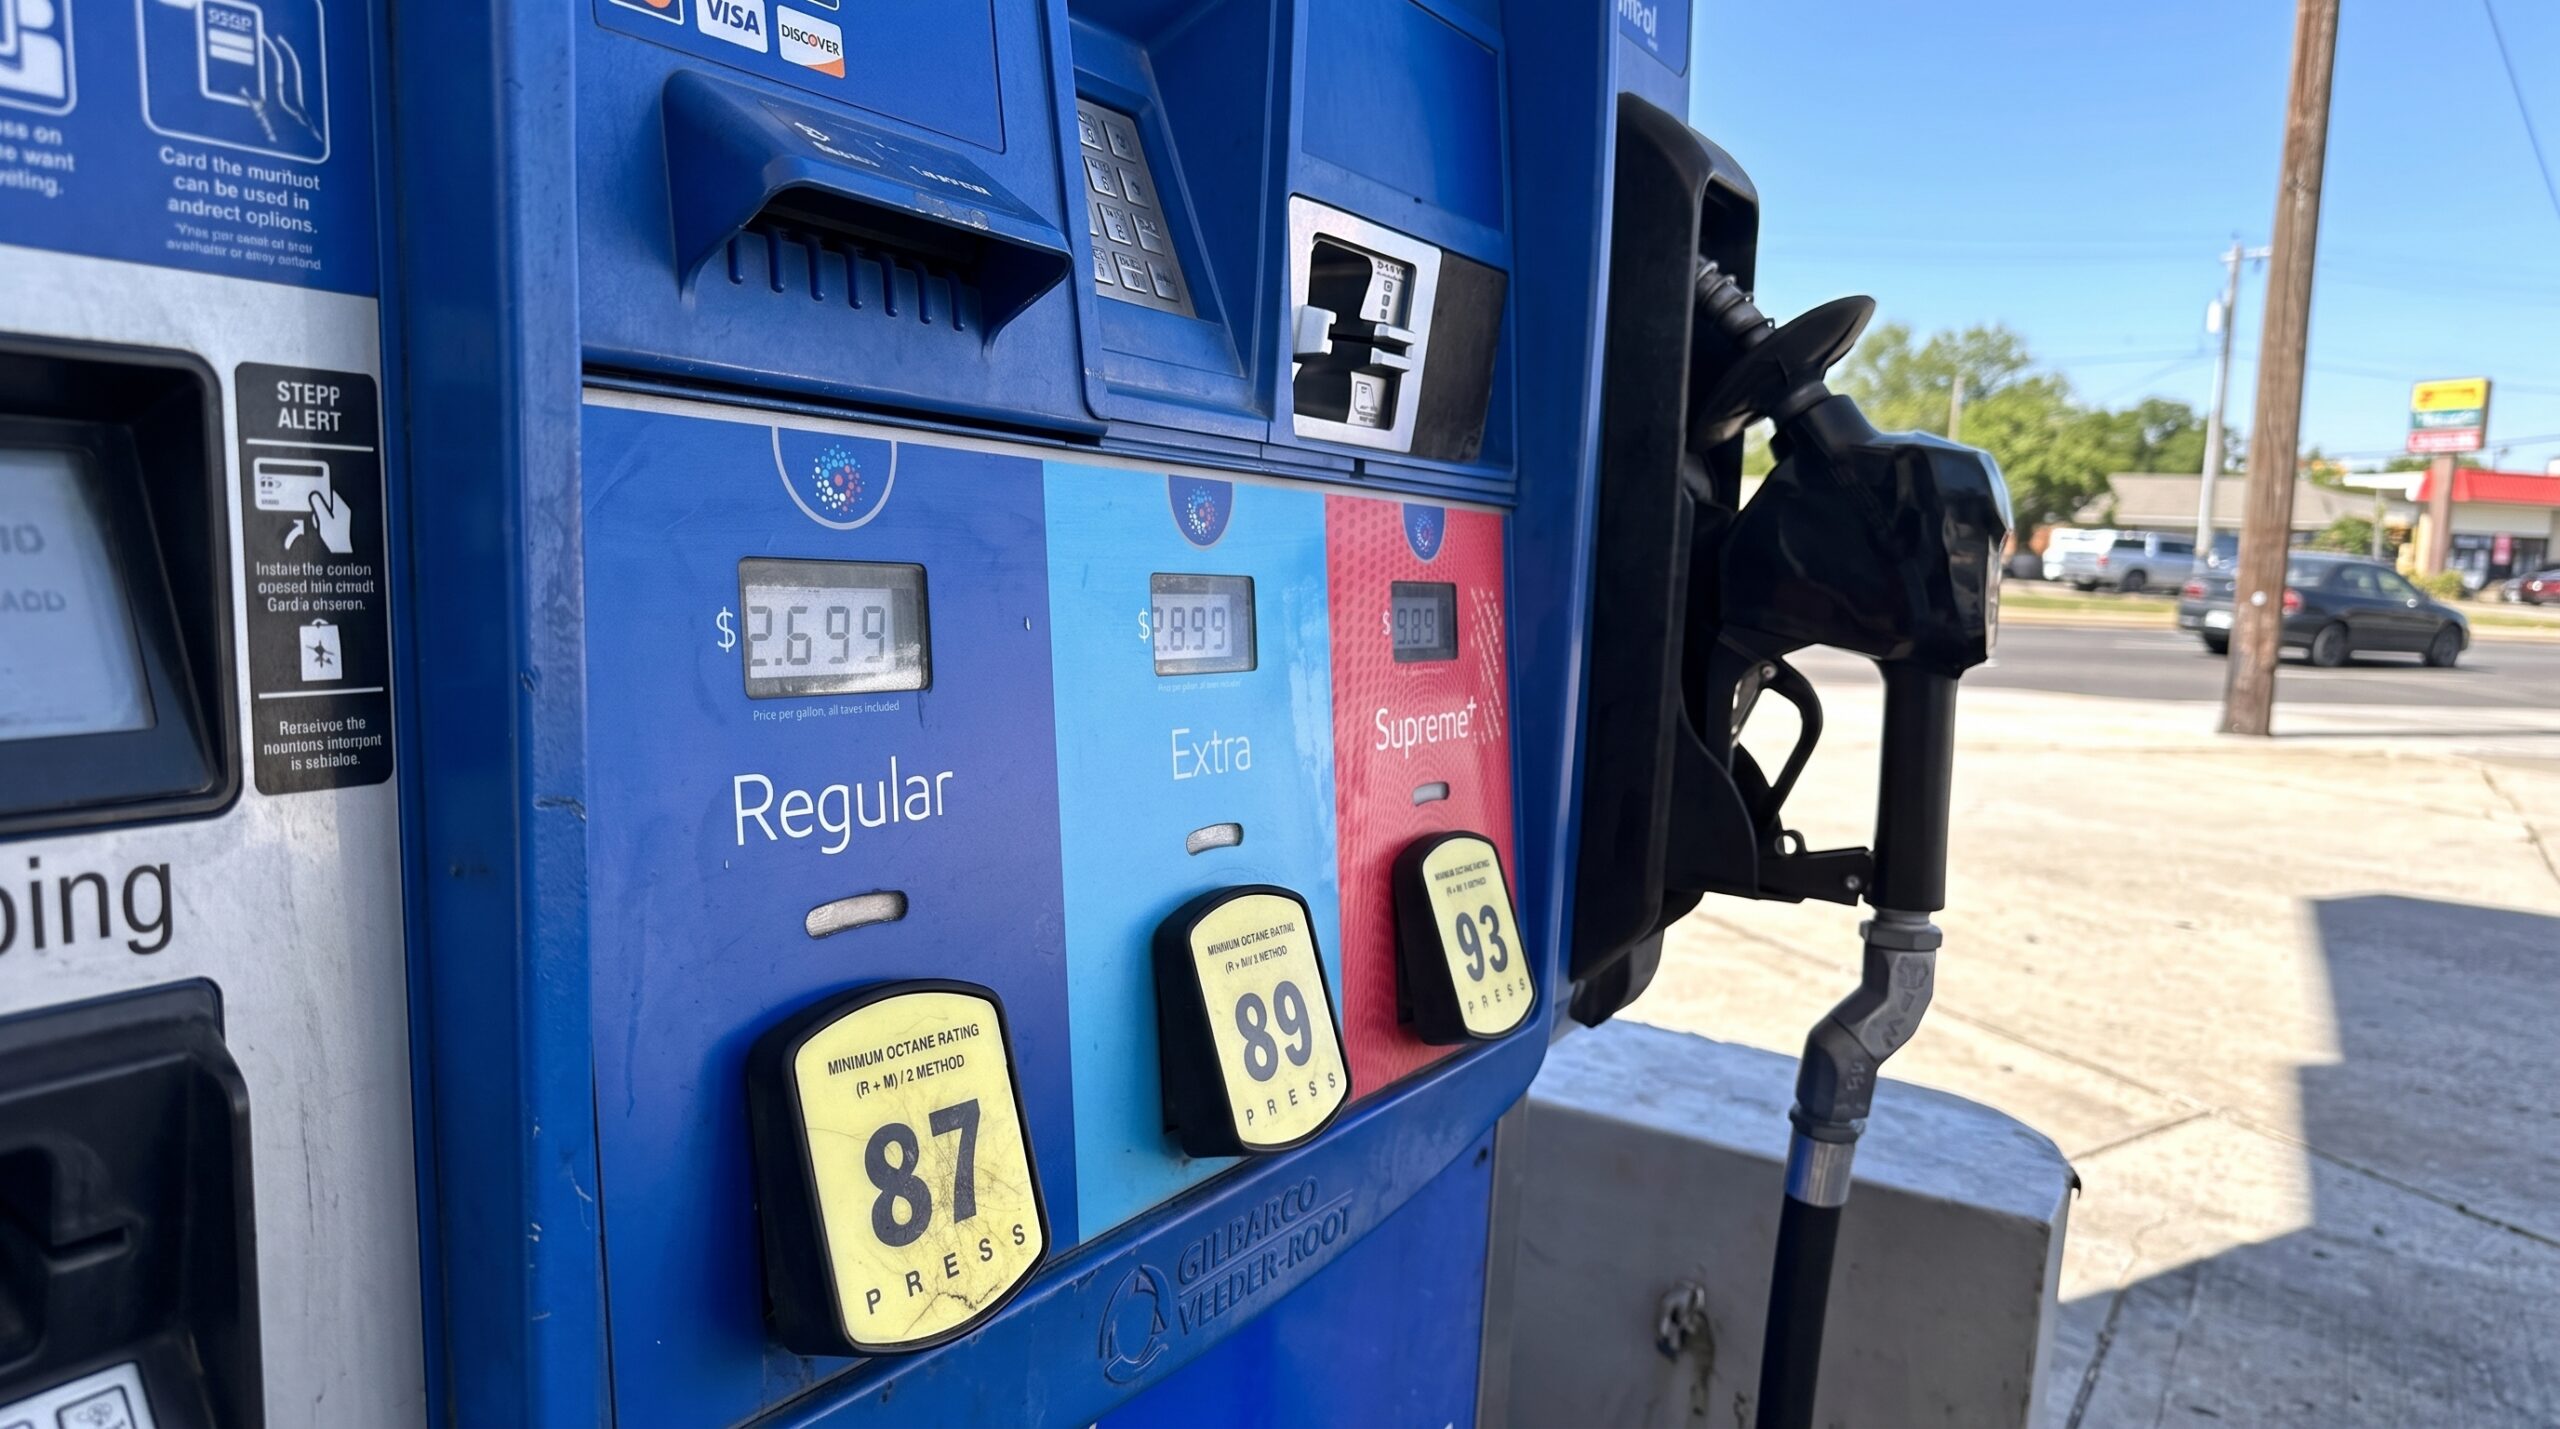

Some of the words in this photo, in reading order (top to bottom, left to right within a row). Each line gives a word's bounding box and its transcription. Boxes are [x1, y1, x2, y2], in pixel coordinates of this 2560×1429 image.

[706, 0, 761, 36] VISA
[781, 23, 841, 57] DISCOVER
[33, 126, 62, 147] on
[159, 145, 207, 171] Card
[212, 157, 242, 177] the
[173, 174, 209, 194] can
[214, 179, 239, 199] be
[244, 189, 288, 207] used
[294, 192, 310, 211] in
[277, 380, 340, 407] STEPP
[277, 406, 342, 432] ALERT
[302, 561, 323, 576] the
[346, 716, 366, 731] the
[753, 710, 777, 721] Price
[779, 710, 794, 722] per
[828, 704, 839, 716] all
[864, 700, 900, 713] included
[291, 755, 302, 771] is
[1171, 728, 1252, 781] Extra
[733, 755, 953, 855] Regular
[1456, 904, 1509, 982] 93
[1235, 980, 1313, 1082] 89
[827, 1048, 884, 1076] MINIMUM
[886, 1034, 936, 1060] OCTANE
[938, 1023, 980, 1046] RATING
[906, 1068, 914, 1083] 2
[916, 1054, 965, 1080] METHOD
[1246, 1072, 1337, 1127] PRESS
[864, 1098, 981, 1248] 87
[1178, 1176, 1318, 1287] GILBARCO
[865, 1223, 1026, 1315] PRESS
[1178, 1204, 1352, 1336] VEEDER-ROOT
